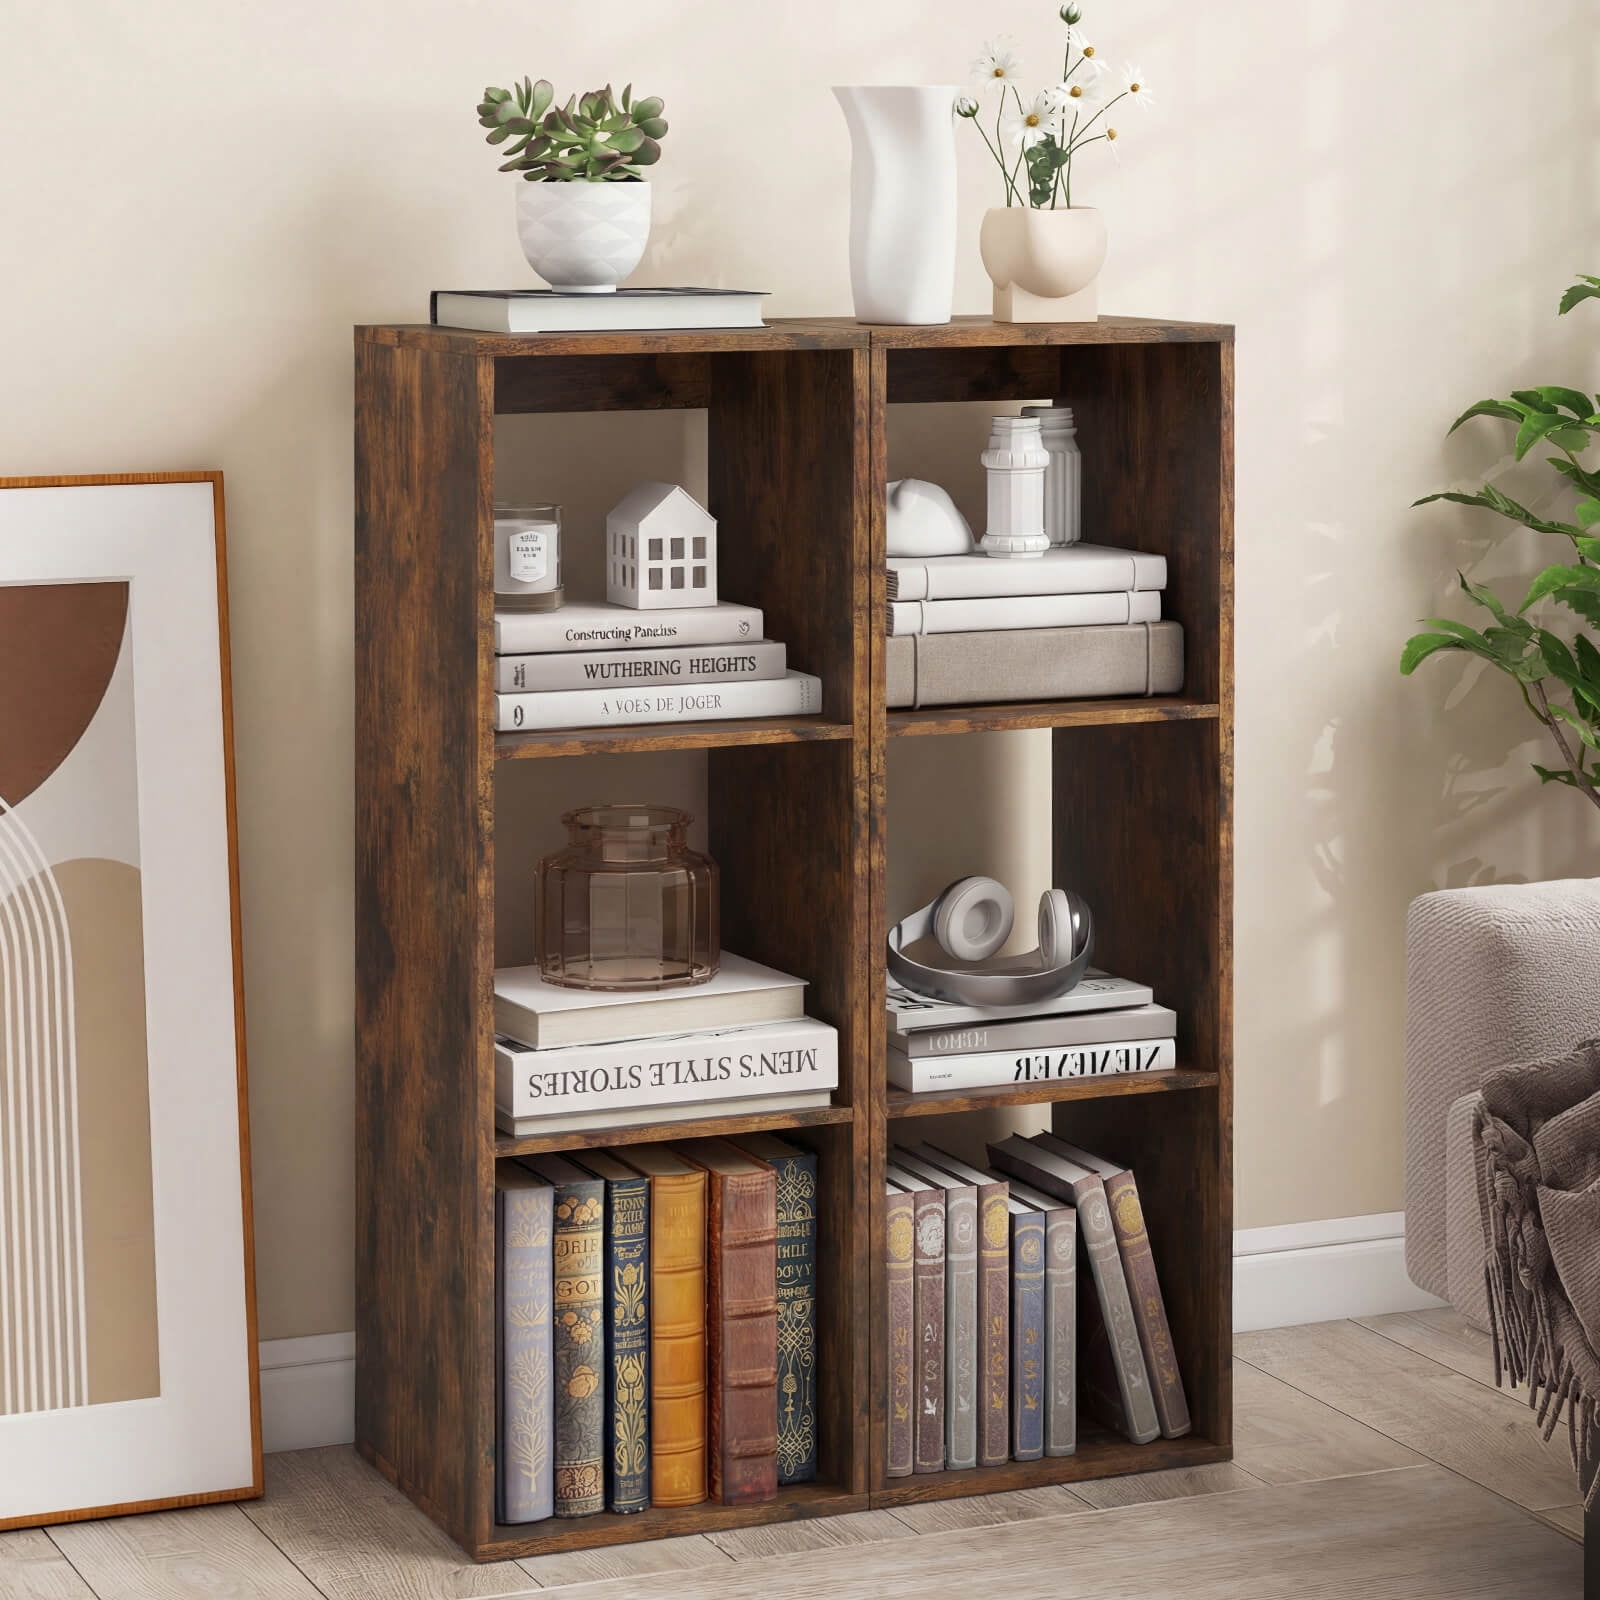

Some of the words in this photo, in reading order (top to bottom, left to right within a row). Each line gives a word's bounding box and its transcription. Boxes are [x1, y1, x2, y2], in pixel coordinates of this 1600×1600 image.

[565, 626, 632, 642] Constructing
[583, 659, 682, 680] WUTHERING
[689, 655, 757, 675] HEIGHTS
[657, 697, 674, 712] DE
[678, 694, 722, 713] JOGER
[649, 1056, 732, 1087] STYLE
[740, 1048, 819, 1078] MEN'S
[528, 1065, 642, 1098] STORIES
